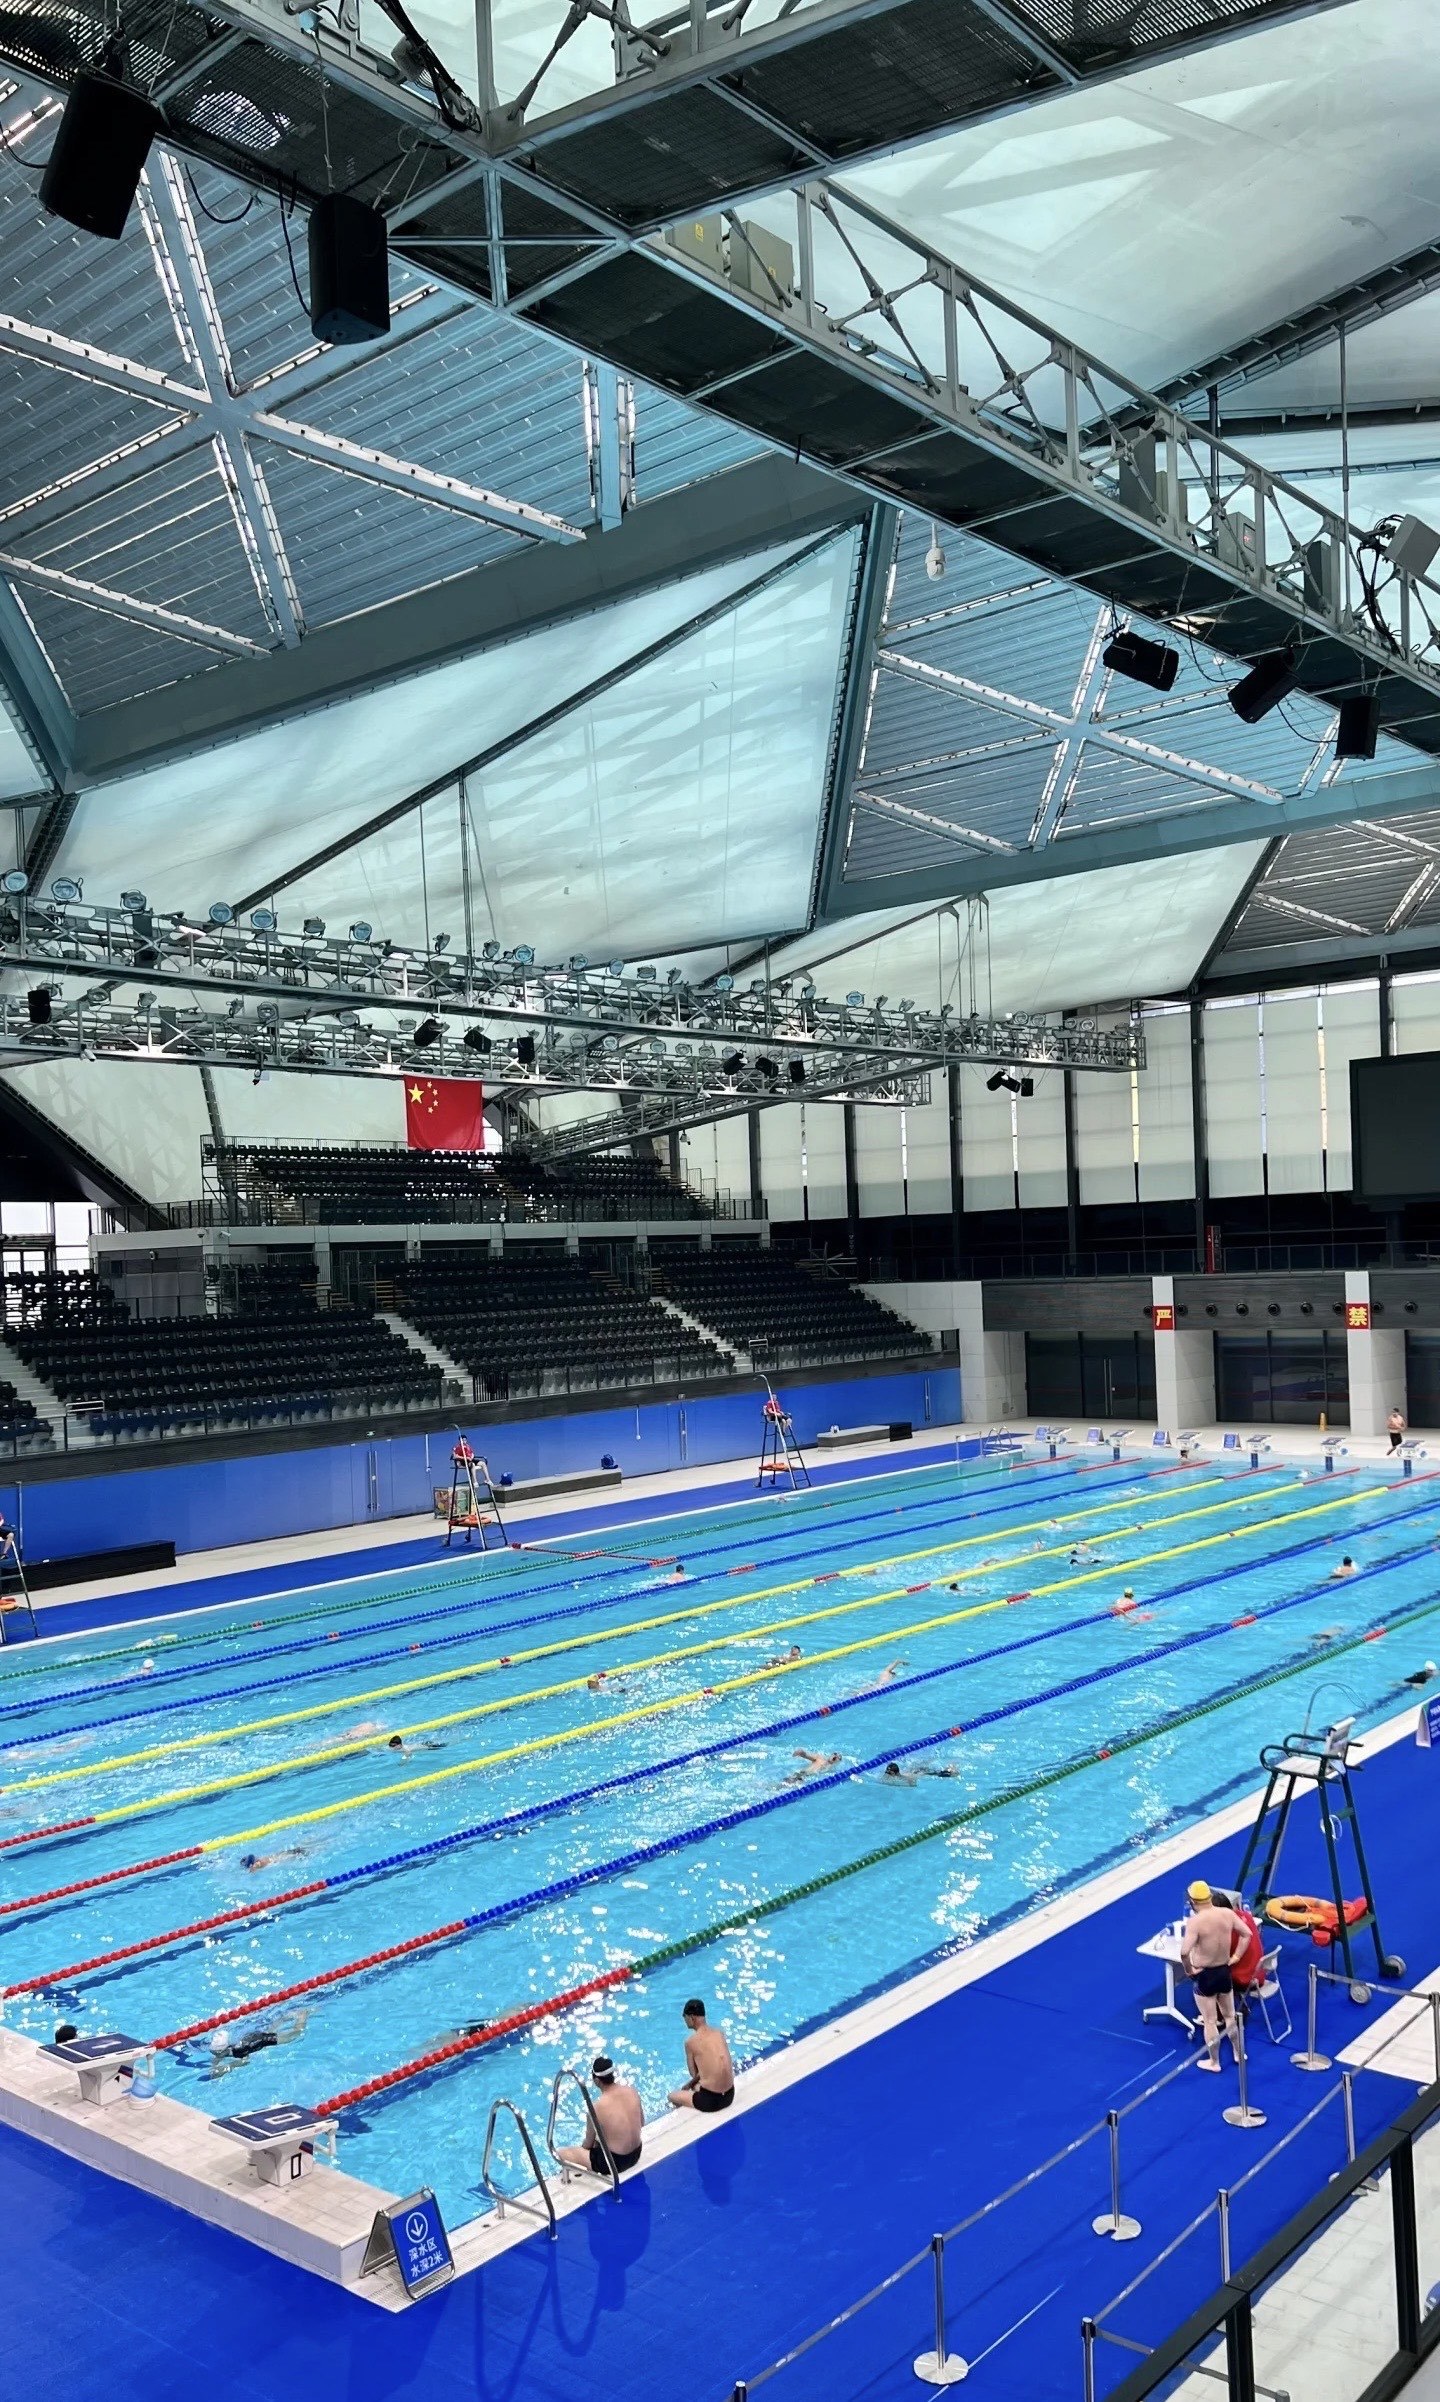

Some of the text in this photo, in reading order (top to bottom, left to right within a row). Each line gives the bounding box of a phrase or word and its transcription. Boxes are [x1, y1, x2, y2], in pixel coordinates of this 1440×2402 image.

[1156, 1309, 1171, 1326] 严
[1348, 1306, 1367, 1326] 禁
[408, 2236, 437, 2262] 深水区
[410, 2250, 443, 2277] 水深2米
